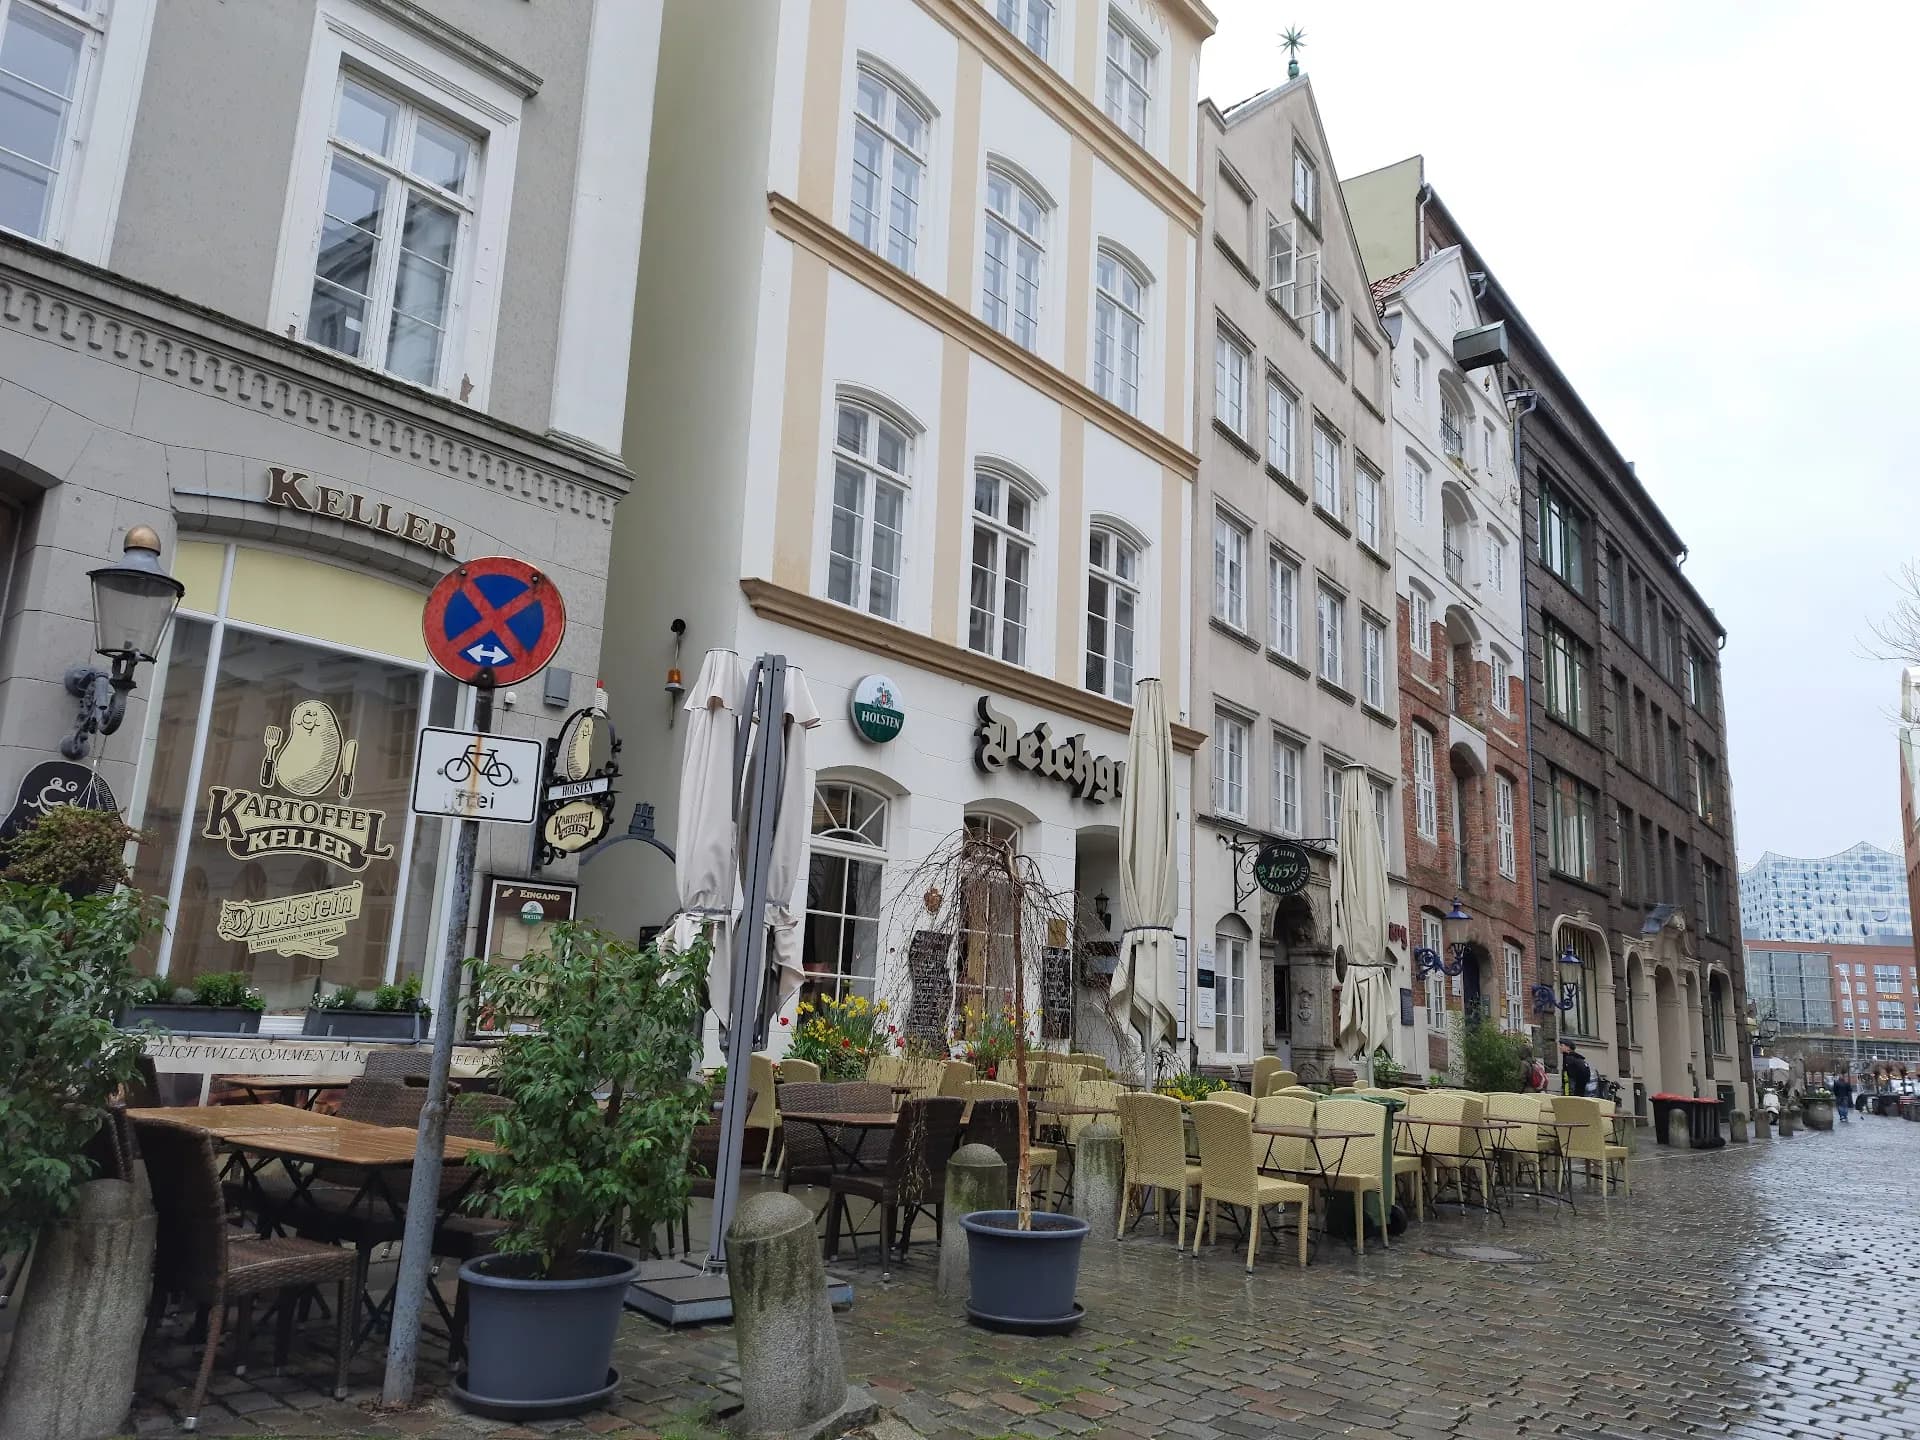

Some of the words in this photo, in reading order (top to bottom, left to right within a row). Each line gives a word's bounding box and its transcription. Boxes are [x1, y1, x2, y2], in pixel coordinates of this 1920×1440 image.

[266, 467, 457, 556] KELLER
[861, 711, 899, 729] HOLSTEN
[562, 781, 593, 797] HOLSTEN
[456, 789, 495, 810] frei
[204, 787, 393, 858] KARTOFFEL
[554, 811, 596, 836] KARTOFFEL
[561, 825, 586, 838] KELLER
[247, 828, 352, 864] KELLER
[1268, 863, 1299, 879] 1659
[520, 889, 560, 901] EINGANG
[221, 891, 353, 938] Duckstein
[148, 1044, 201, 1058] ZLICH
[205, 1045, 327, 1062] WILLKOMMEN
[330, 1049, 350, 1061] IM
